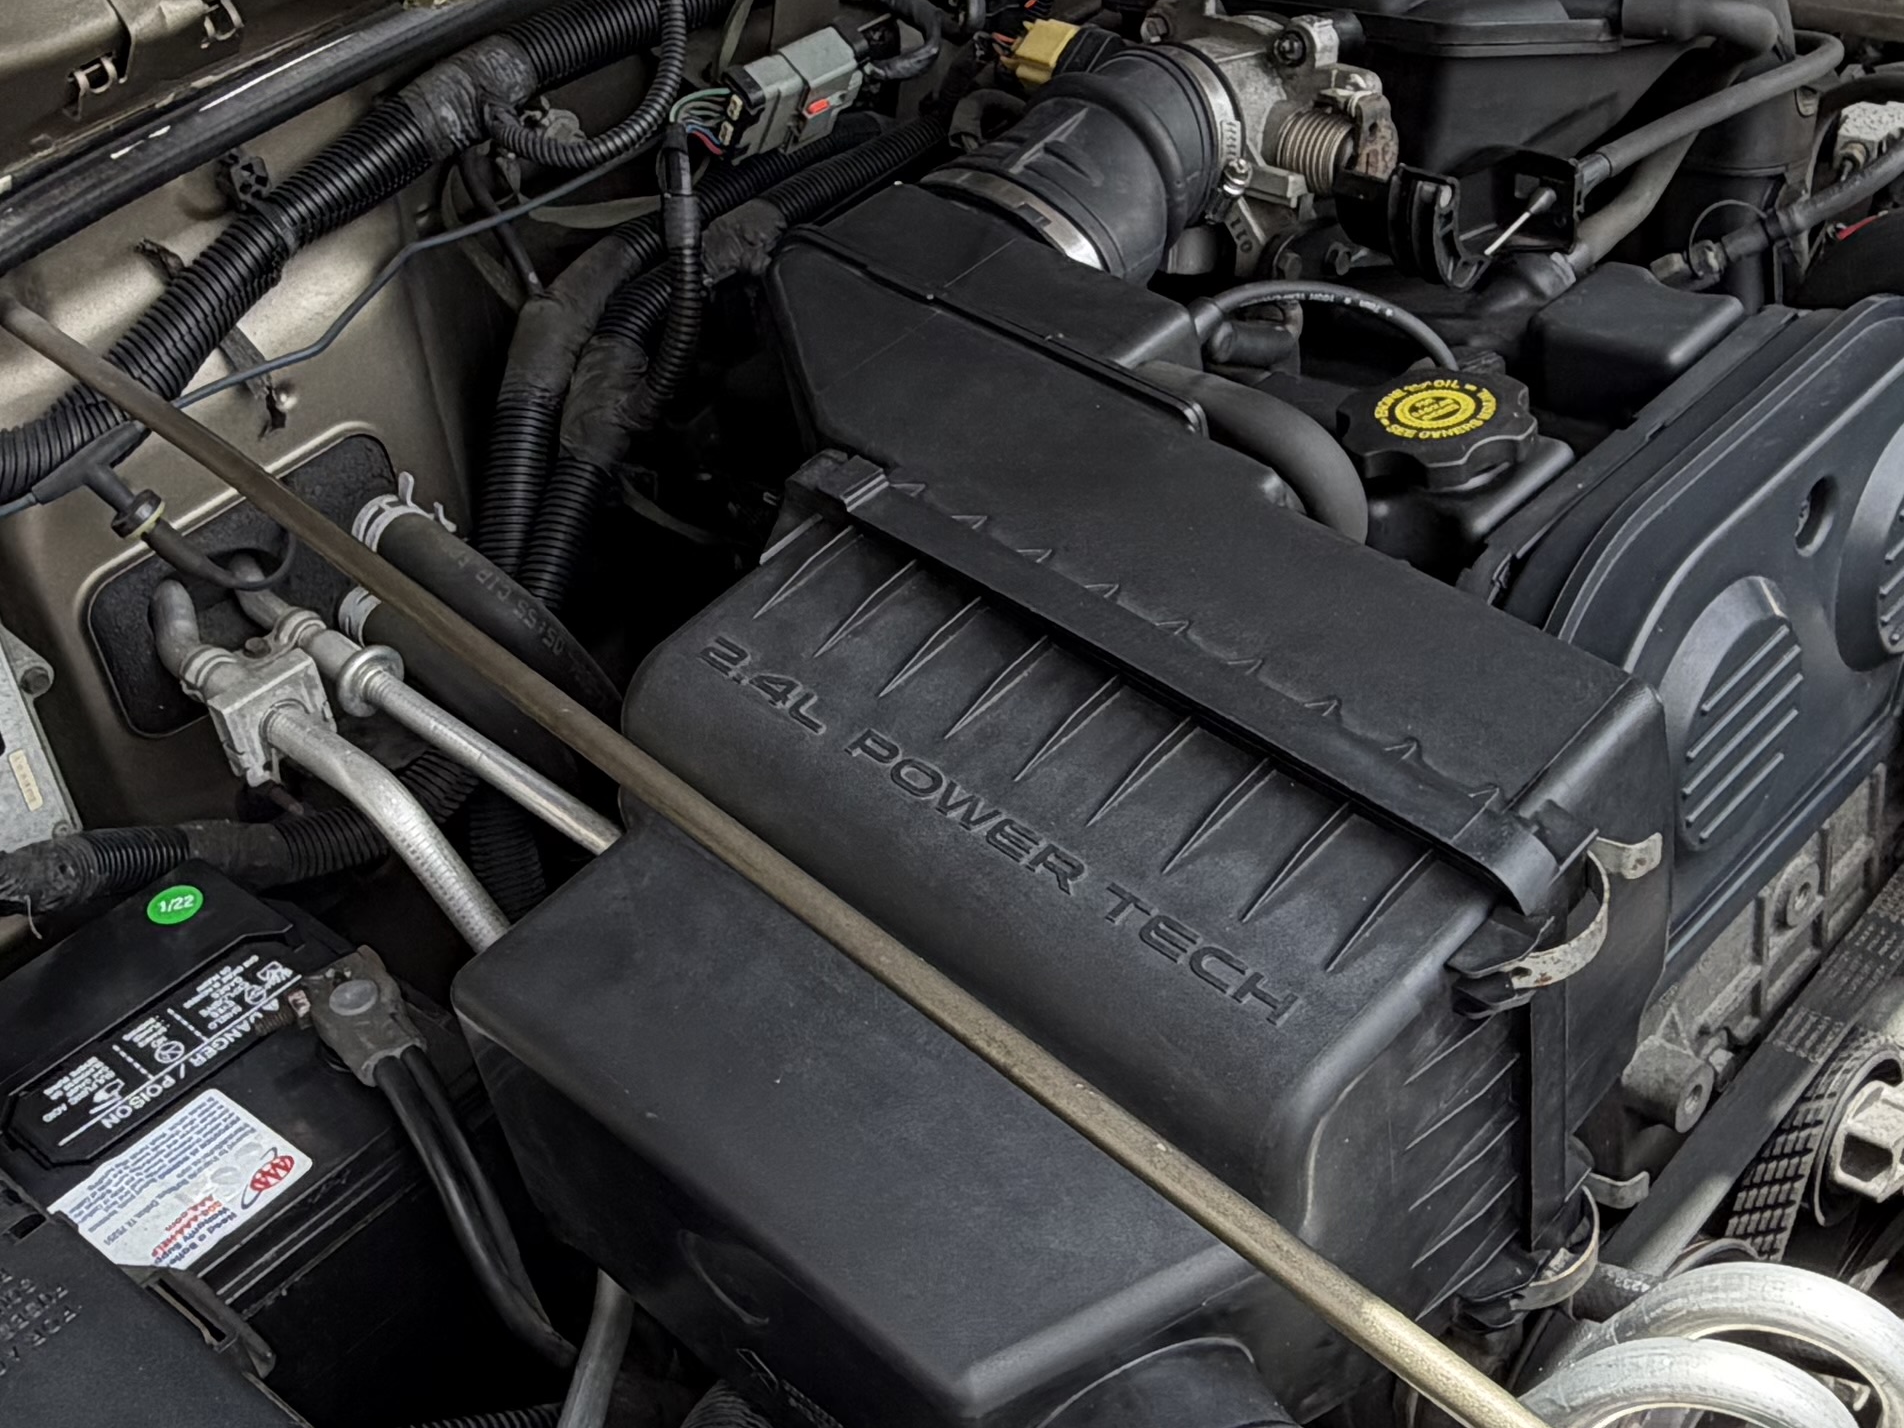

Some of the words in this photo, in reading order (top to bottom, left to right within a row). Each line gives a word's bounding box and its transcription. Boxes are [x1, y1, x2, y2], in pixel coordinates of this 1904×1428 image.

[1433, 379, 1460, 389] OIL
[698, 637, 827, 736] 2.4L
[846, 727, 1088, 897] POWER
[1104, 883, 1303, 1028] TECH
[158, 894, 195, 912] 1/22
[40, 1102, 69, 1123] ACID
[98, 1073, 177, 1129] POISON
[245, 1153, 296, 1193] AAA
[164, 1190, 215, 1235] AAA.com
[206, 1208, 237, 1236] Need
[24, 1305, 77, 1348] FOR
